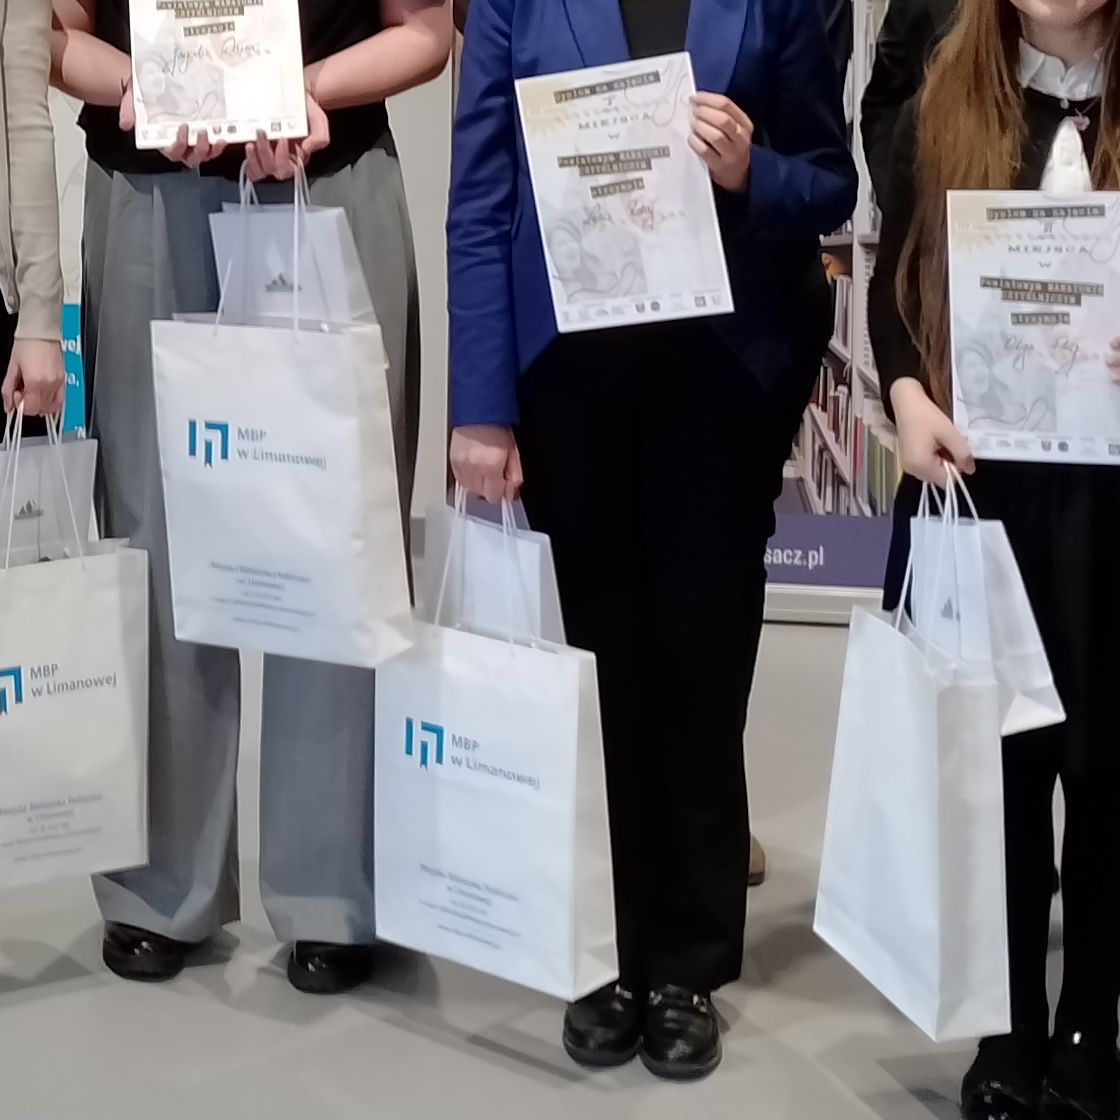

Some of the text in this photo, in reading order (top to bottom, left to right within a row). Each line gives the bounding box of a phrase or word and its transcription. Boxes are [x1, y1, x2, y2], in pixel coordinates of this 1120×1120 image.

[764, 545, 824, 570] sacz.pl
[30, 664, 59, 679] MBP
[31, 672, 117, 697] w Limanowej
[452, 734, 480, 752] MBP
